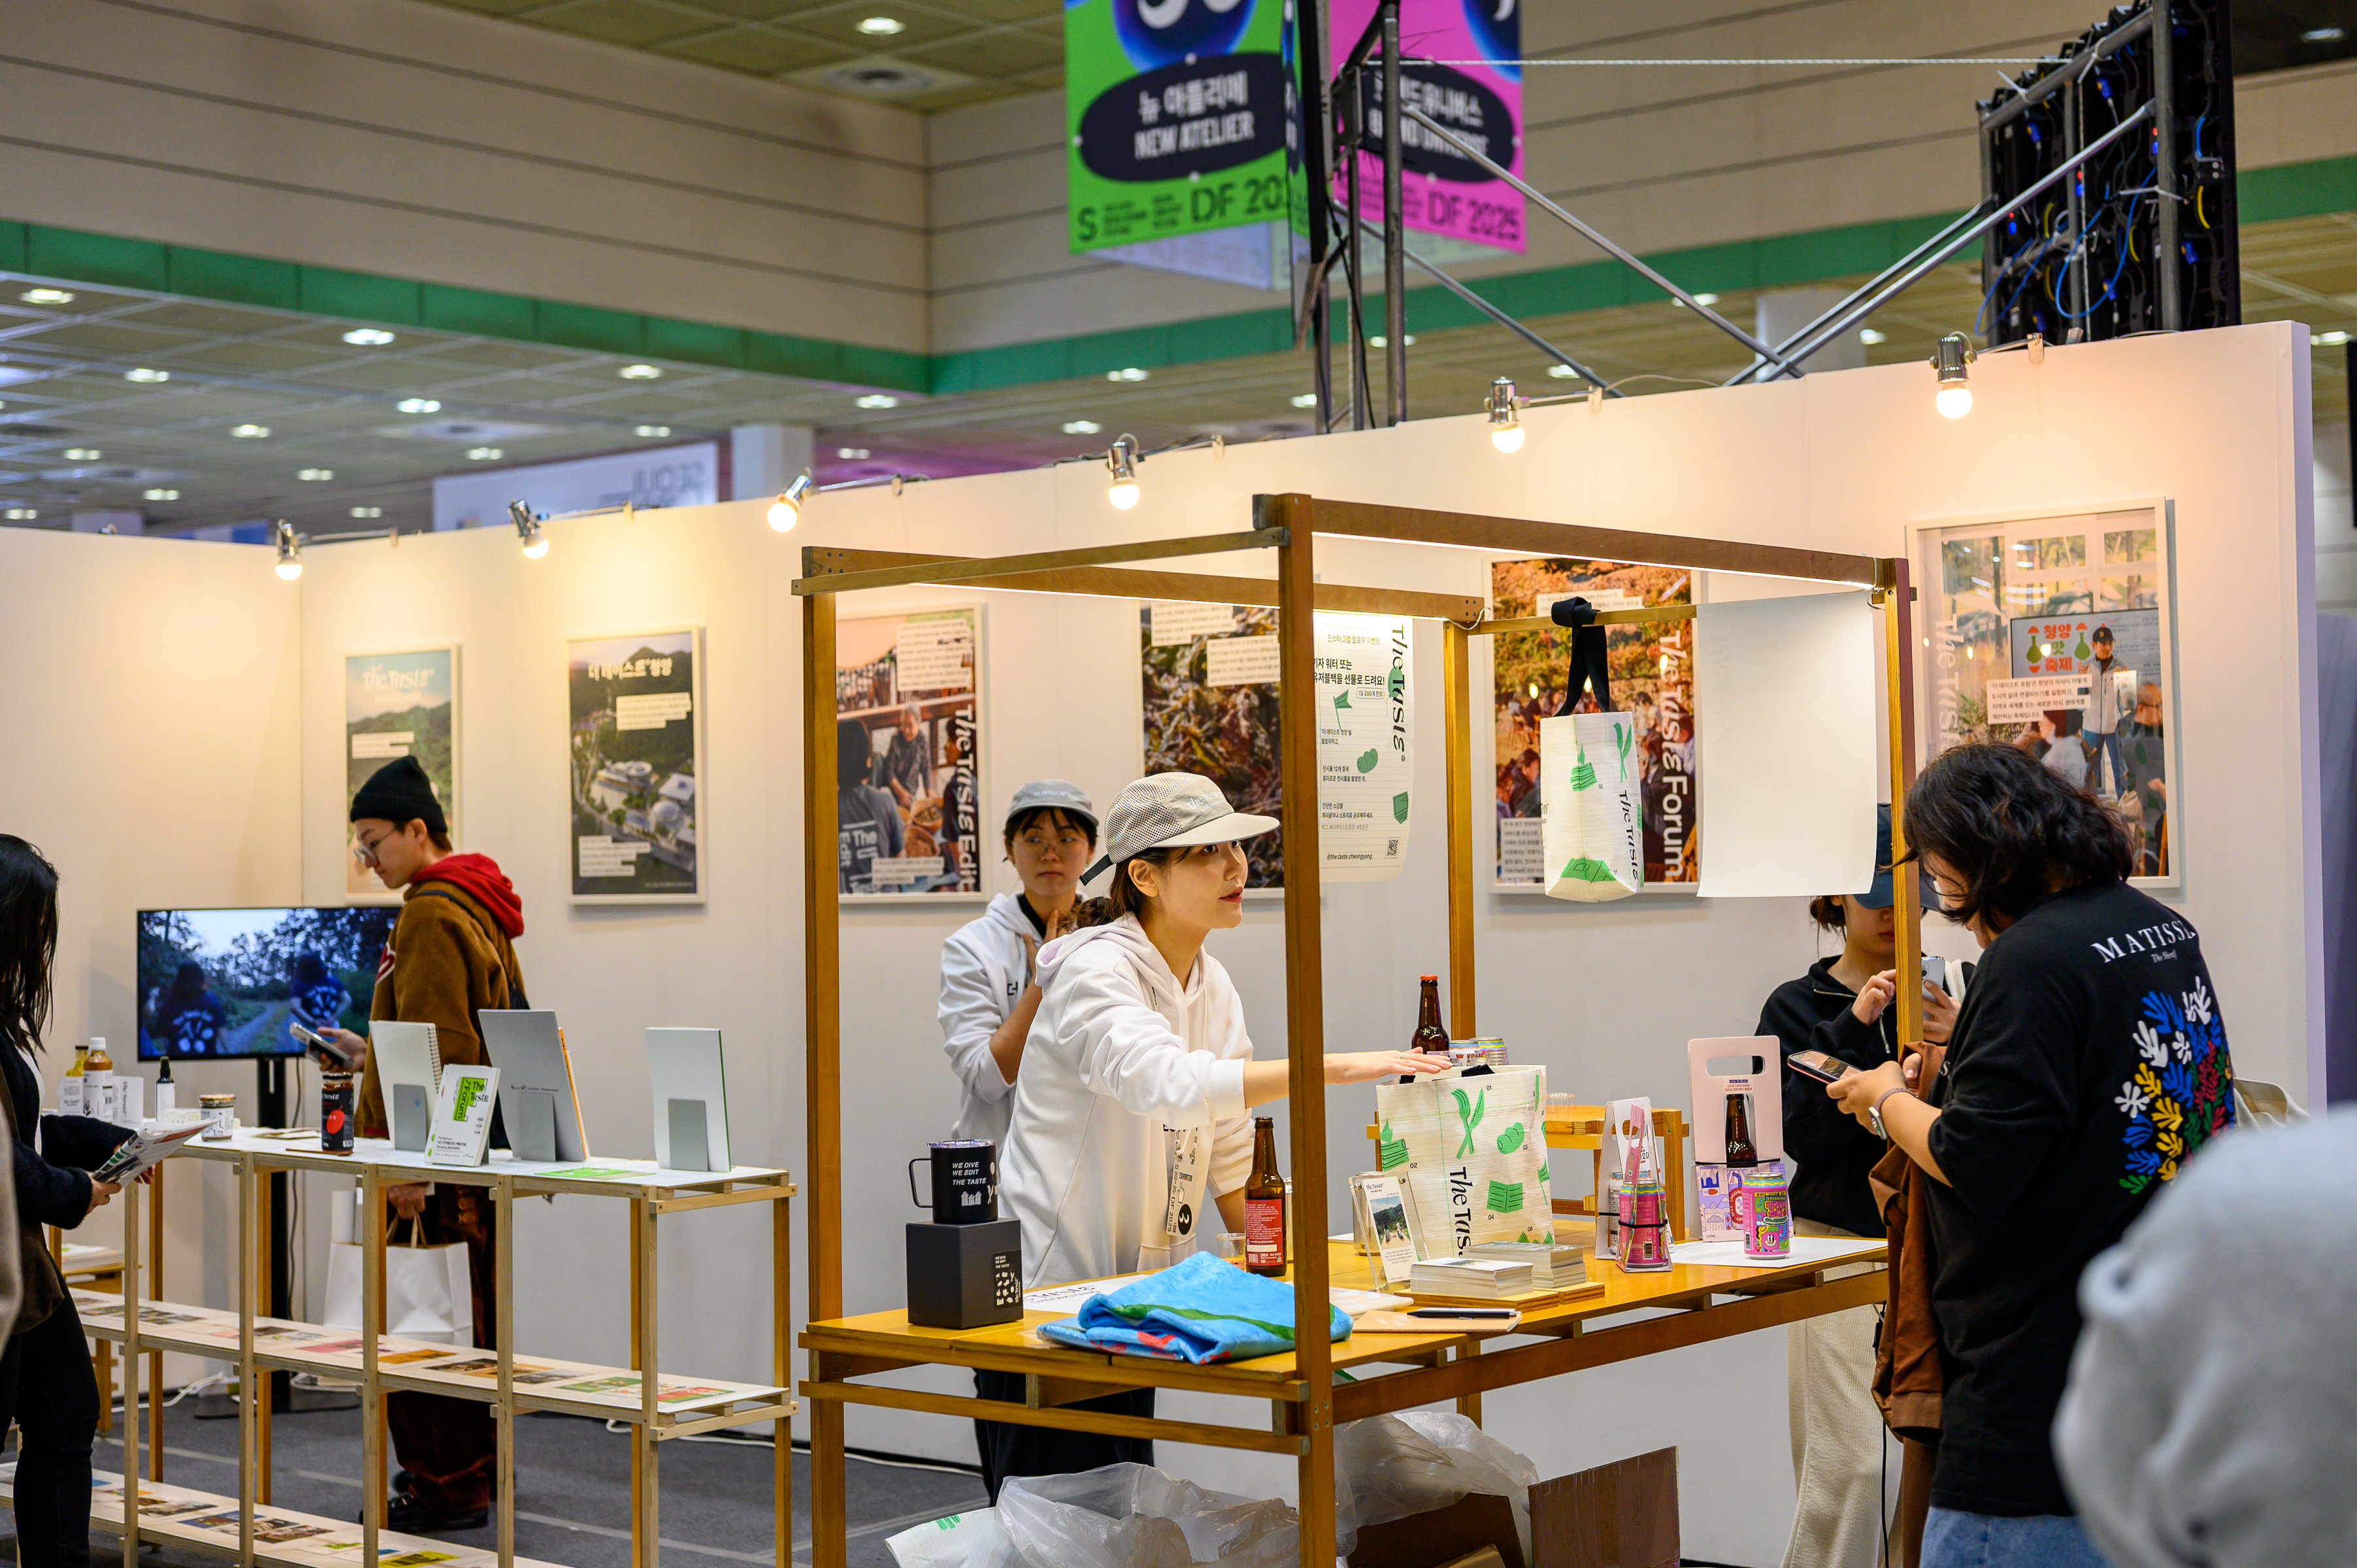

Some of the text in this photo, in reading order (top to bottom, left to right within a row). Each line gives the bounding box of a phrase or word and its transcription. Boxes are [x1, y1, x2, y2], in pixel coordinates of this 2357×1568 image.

[1134, 124, 1178, 161] NEW
[1178, 110, 1255, 152] ATELIER
[1078, 207, 1098, 242] S
[1191, 182, 1237, 223] DF
[1243, 175, 1283, 216] 20
[1327, 634, 1351, 644] 인스타그램
[1352, 636, 1366, 644] 팔로우
[1393, 625, 1408, 670] The
[2044, 623, 2071, 640] 청양
[2051, 640, 2065, 655] 맛
[588, 664, 600, 681] 더
[601, 659, 647, 680] 테이스트
[1326, 658, 1338, 669] 워터
[1340, 659, 1352, 670] 또는
[1658, 630, 1687, 684] The
[2045, 657, 2072, 672] 축제
[1344, 674, 1363, 685] 선물로
[1364, 675, 1385, 686] 드려요!
[954, 704, 977, 751] The
[1937, 672, 1960, 752] Tast
[1185, 797, 1204, 809] The
[1619, 790, 1631, 823] The
[1662, 776, 1687, 877] Forum
[957, 834, 978, 892] Edit
[472, 1081, 485, 1092] The
[1449, 1166, 1473, 1258] The Tas
